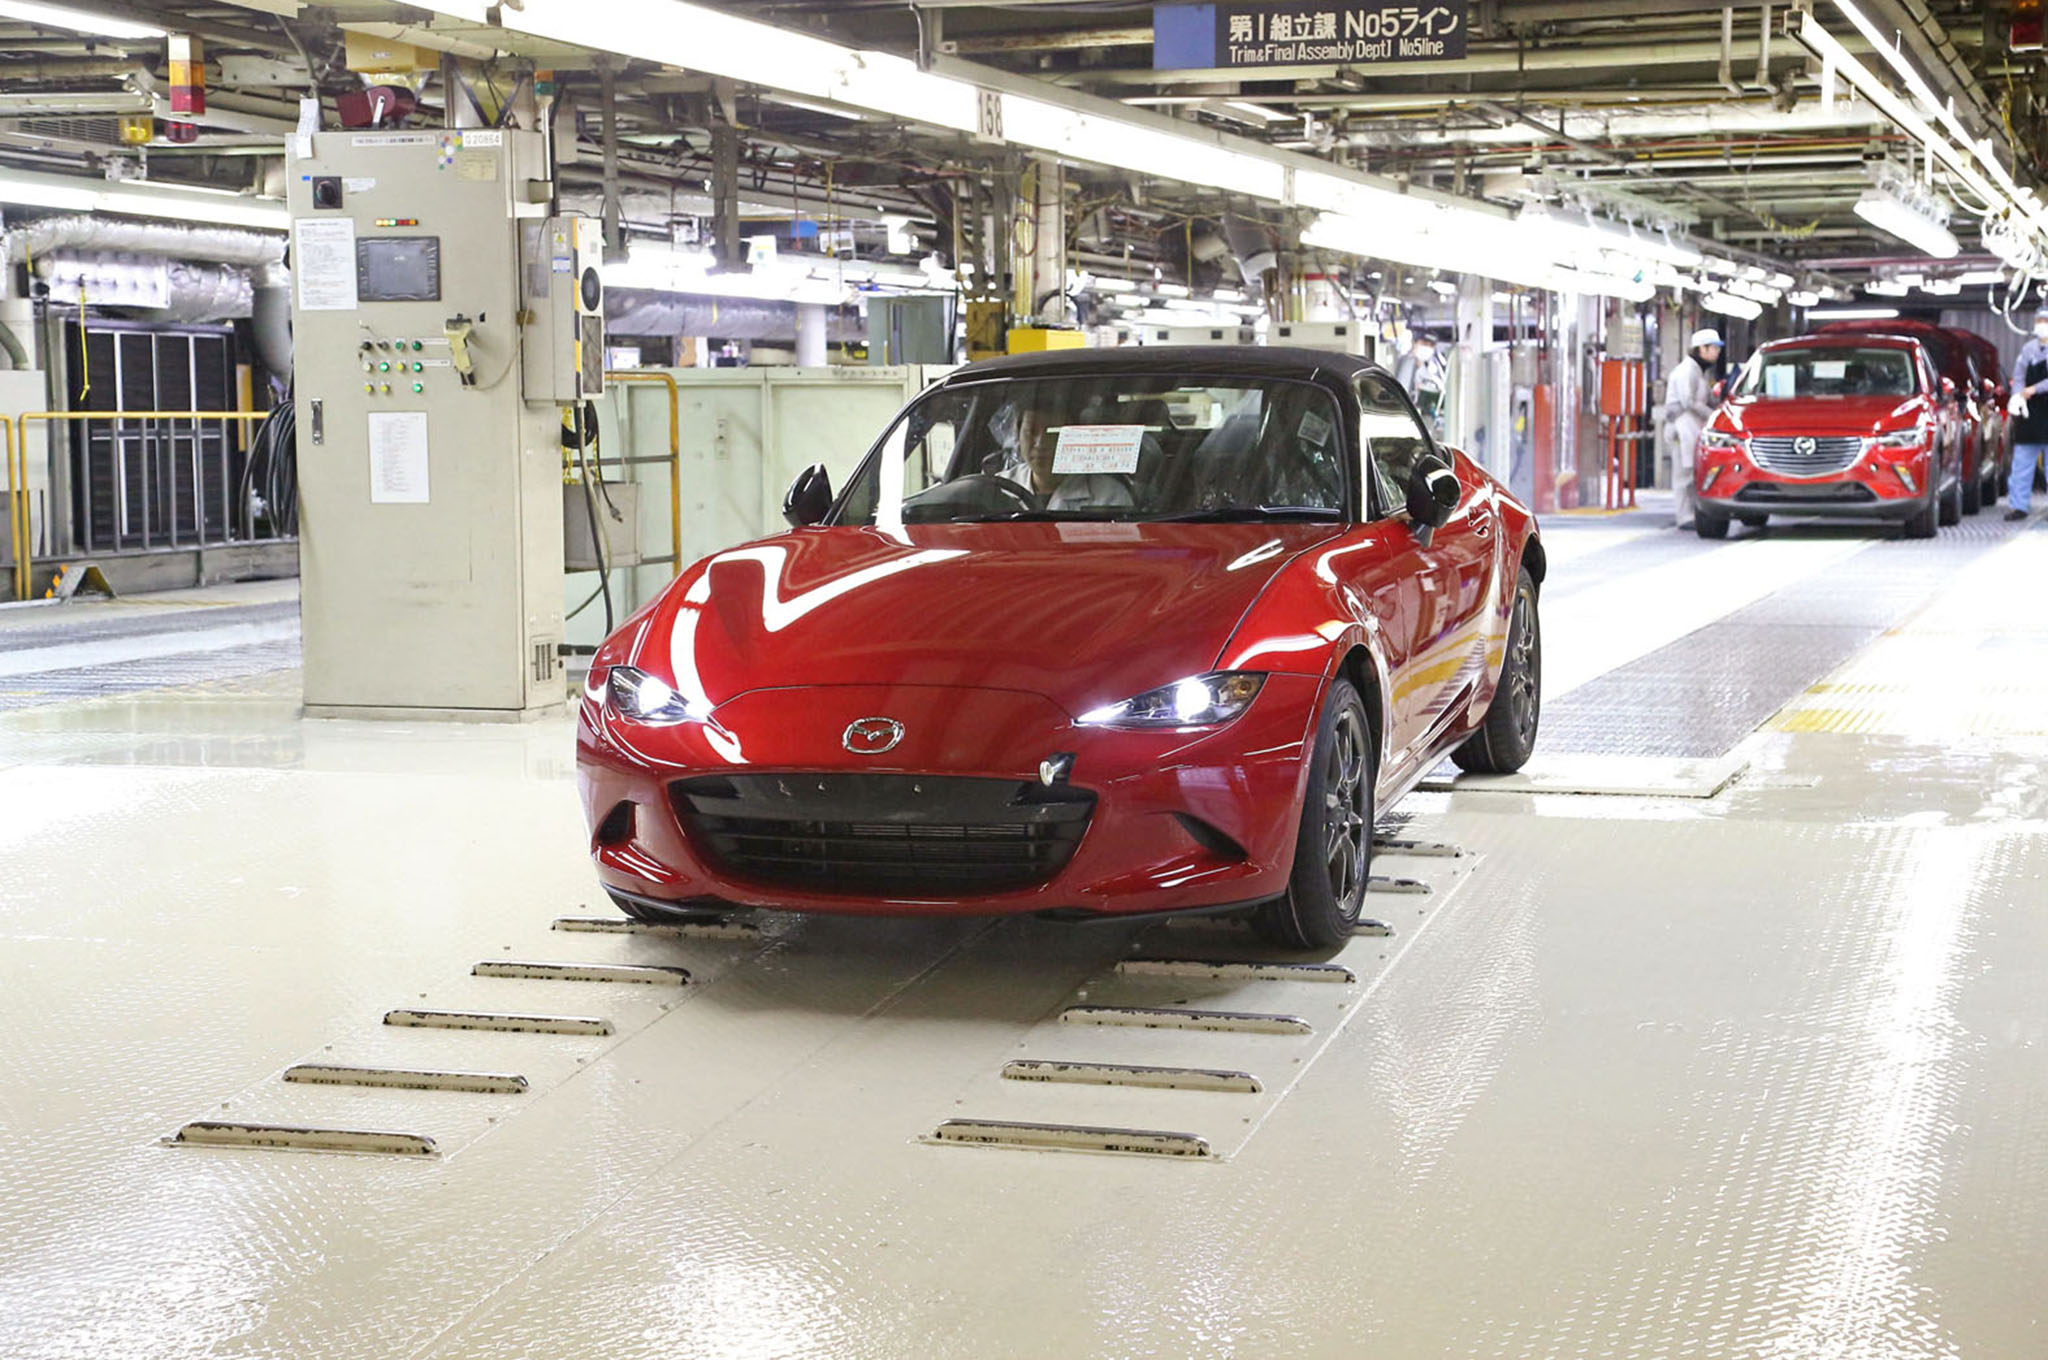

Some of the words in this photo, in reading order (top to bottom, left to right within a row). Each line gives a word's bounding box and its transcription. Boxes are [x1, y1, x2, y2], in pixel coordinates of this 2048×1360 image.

[1345, 7, 1458, 38] No5ライン
[1229, 43, 1296, 63] Trim&Final
[1297, 40, 1354, 62] Assembly
[1399, 37, 1444, 57] No5line
[979, 91, 1003, 138] 158
